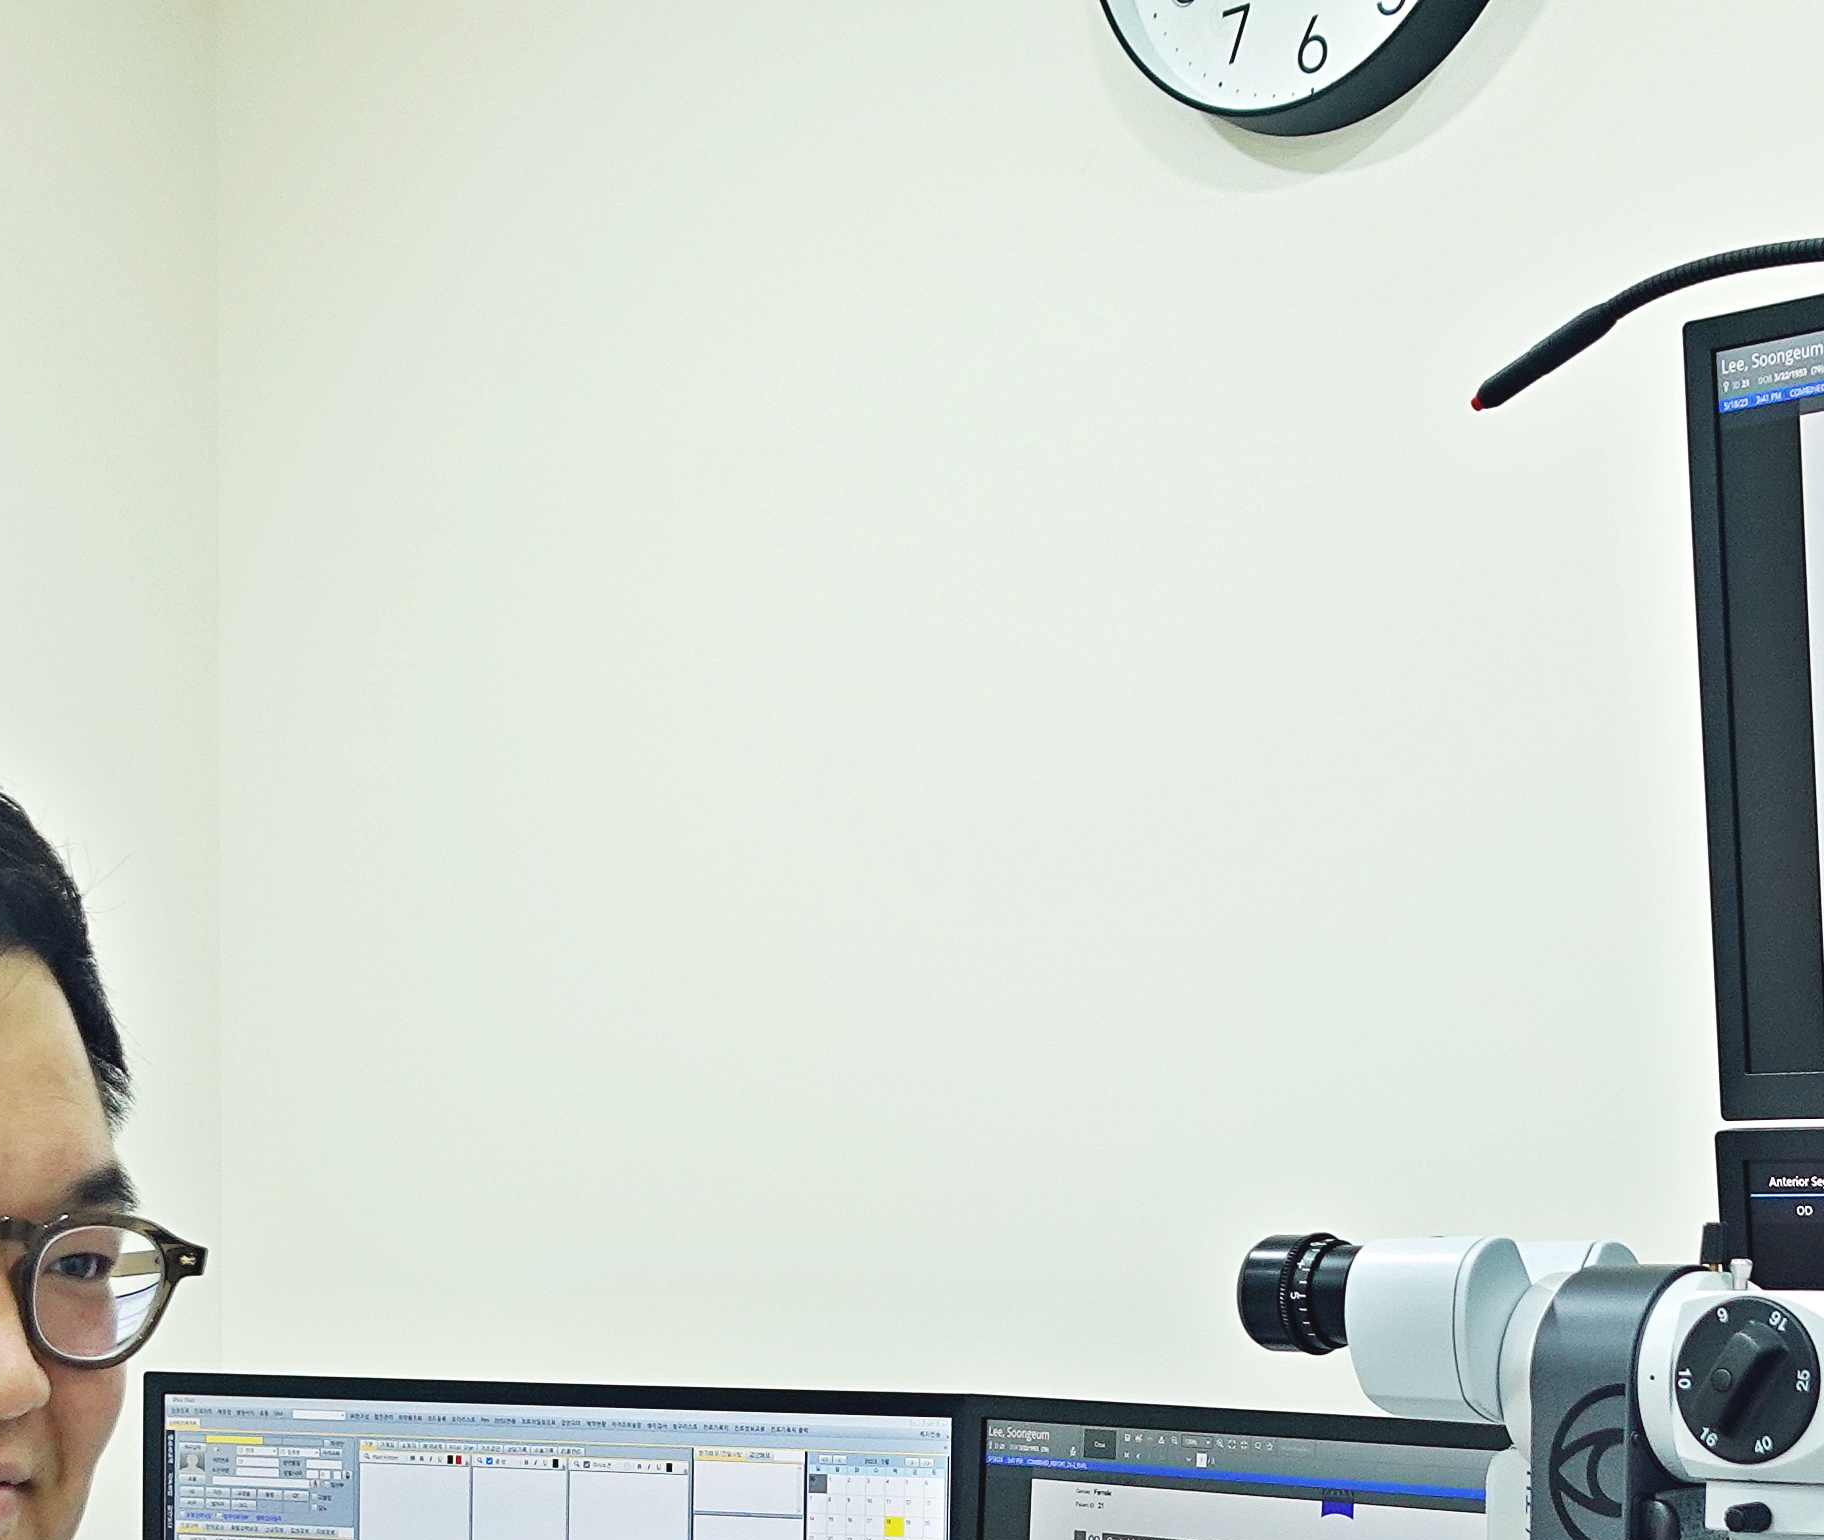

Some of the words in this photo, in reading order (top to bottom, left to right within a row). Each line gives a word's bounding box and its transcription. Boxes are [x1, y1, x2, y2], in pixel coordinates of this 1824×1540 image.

[1222, 3, 1251, 65] 7
[1297, 14, 1327, 74] 6
[1721, 358, 1749, 374] Lee,
[1751, 342, 1824, 369] Soongeum
[1768, 1175, 1810, 1188] Anterior
[1796, 1205, 1814, 1216] OD
[1768, 1310, 1788, 1332] 16
[1677, 1368, 1693, 1389] 10
[1796, 1369, 1811, 1392] 25
[988, 1425, 1005, 1438] Lee,
[1006, 1426, 1050, 1442] Soongeum
[1700, 1426, 1718, 1447] 16
[1754, 1435, 1773, 1454] 40
